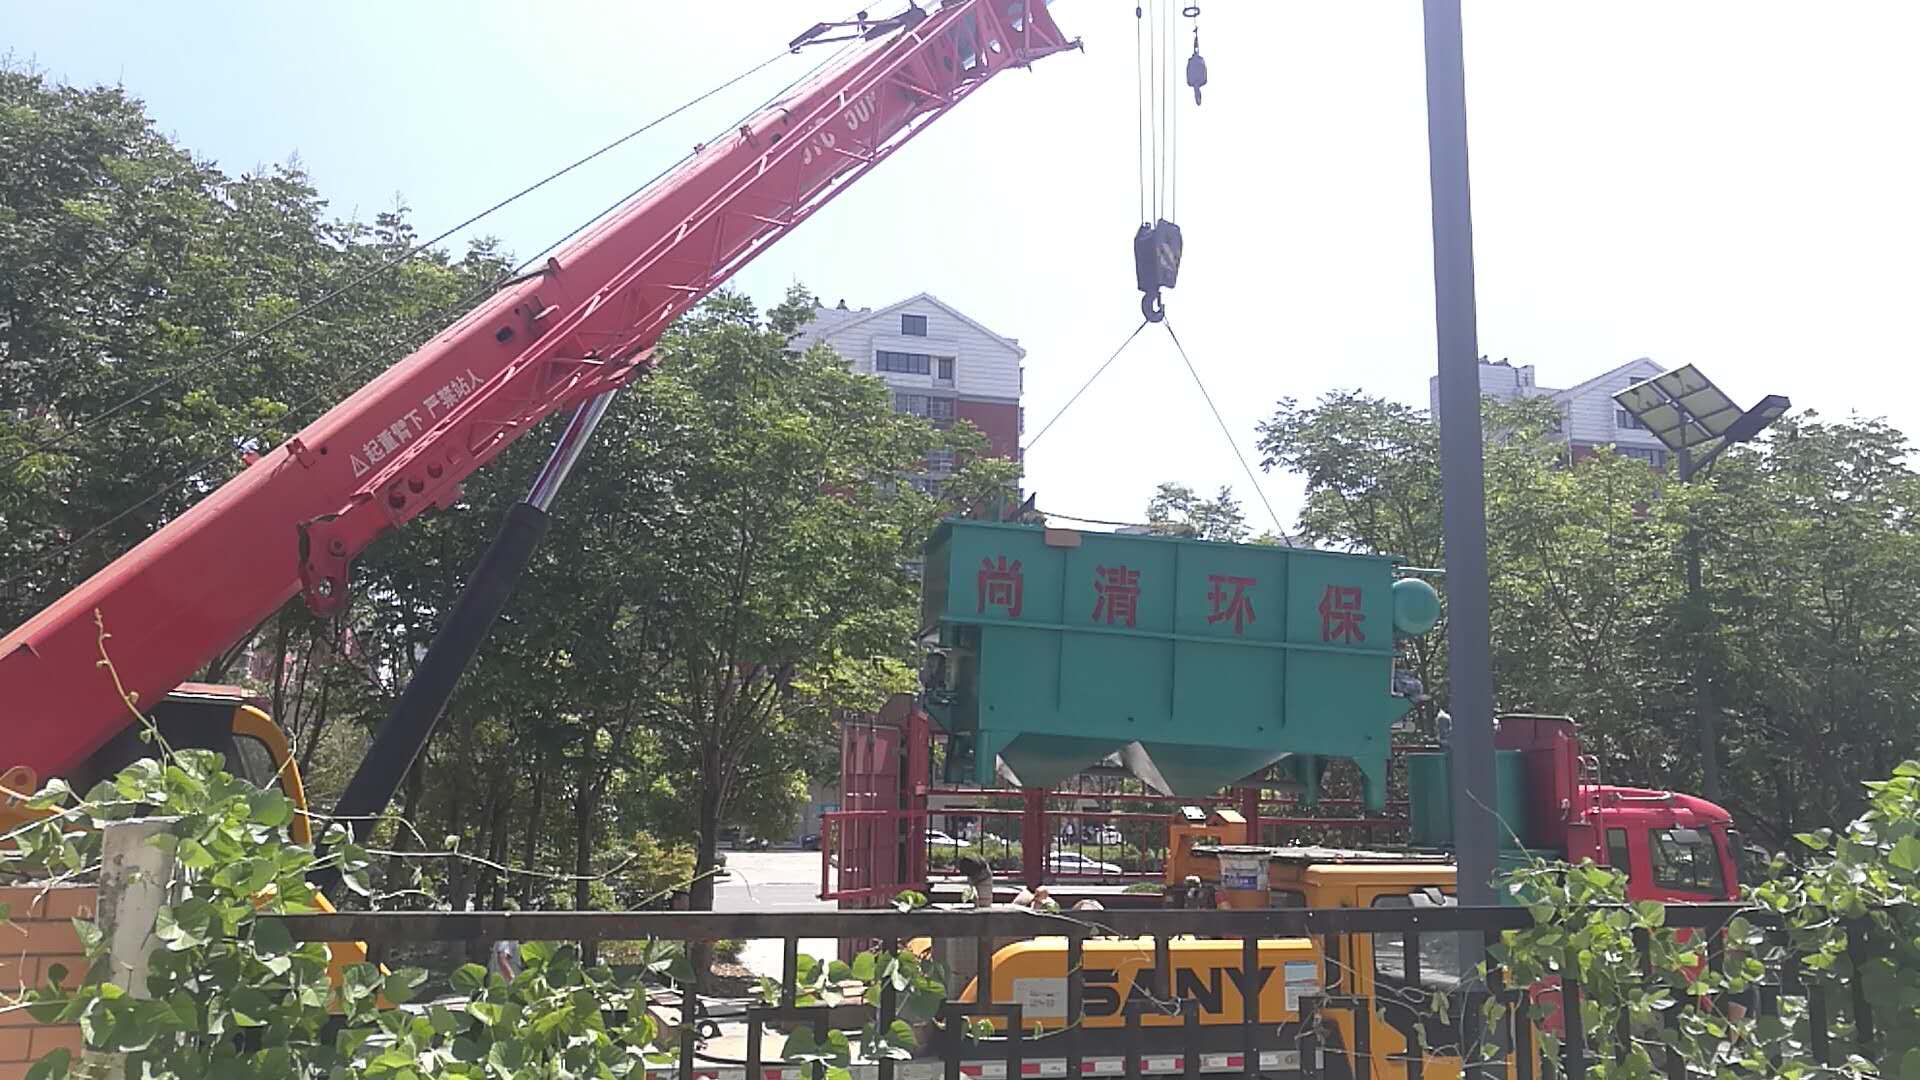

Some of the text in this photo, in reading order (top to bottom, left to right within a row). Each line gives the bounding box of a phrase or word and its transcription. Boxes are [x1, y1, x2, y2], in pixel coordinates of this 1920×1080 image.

[362, 368, 485, 464] 起重臂下 严禁站人
[976, 555, 1365, 644] 尚清环保
[1080, 966, 1276, 1017] SANY
